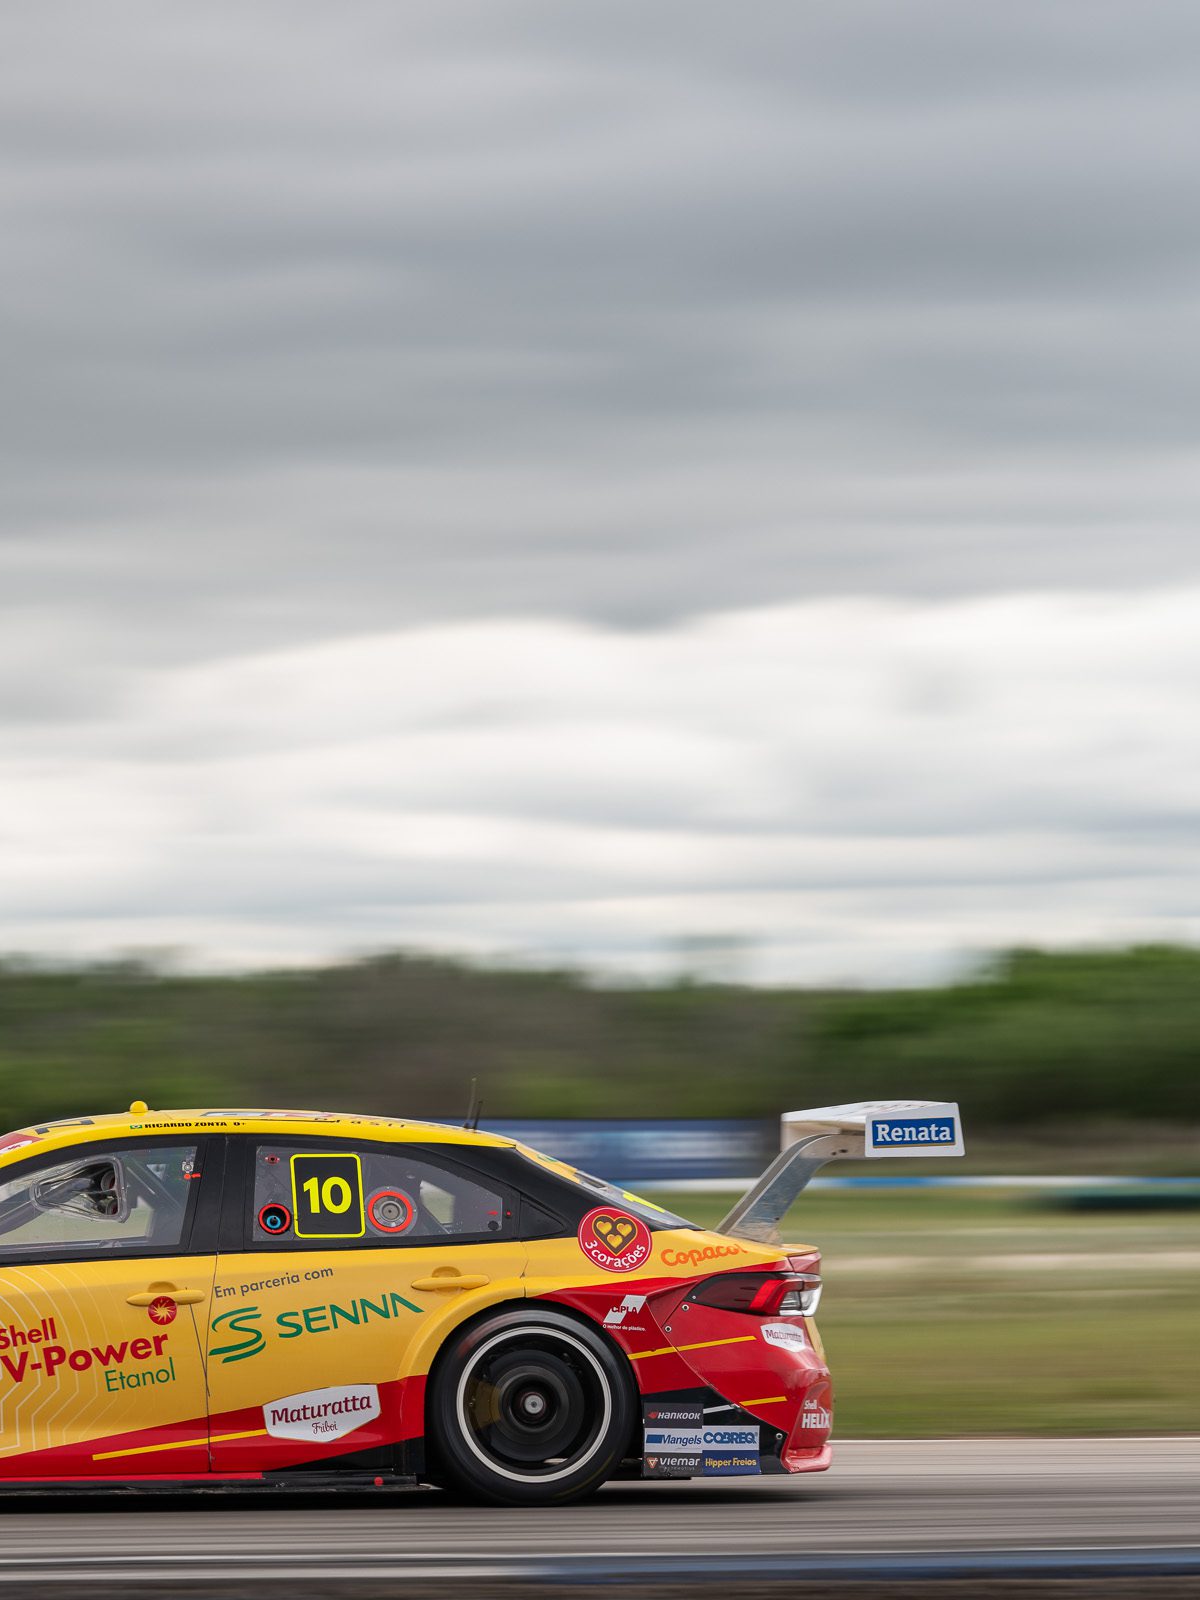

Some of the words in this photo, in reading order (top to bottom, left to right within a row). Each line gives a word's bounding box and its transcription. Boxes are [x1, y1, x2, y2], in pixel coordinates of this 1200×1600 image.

[875, 1123, 952, 1142] Renata
[303, 1176, 352, 1214] 10
[585, 1240, 598, 1250] 3
[591, 1244, 646, 1269] corações
[214, 1285, 236, 1299] Em
[240, 1272, 300, 1296] parceria
[304, 1266, 334, 1281] com
[276, 1292, 425, 1338] SENNA
[0, 1333, 169, 1383] V-Power
[104, 1356, 176, 1393] Etanol
[270, 1395, 372, 1426] Maturatta
[804, 1399, 818, 1410] Shell
[311, 1420, 339, 1435] Friboi
[801, 1412, 831, 1429] HELIX
[705, 1457, 731, 1468] Hipper
[732, 1457, 757, 1466] Freios
